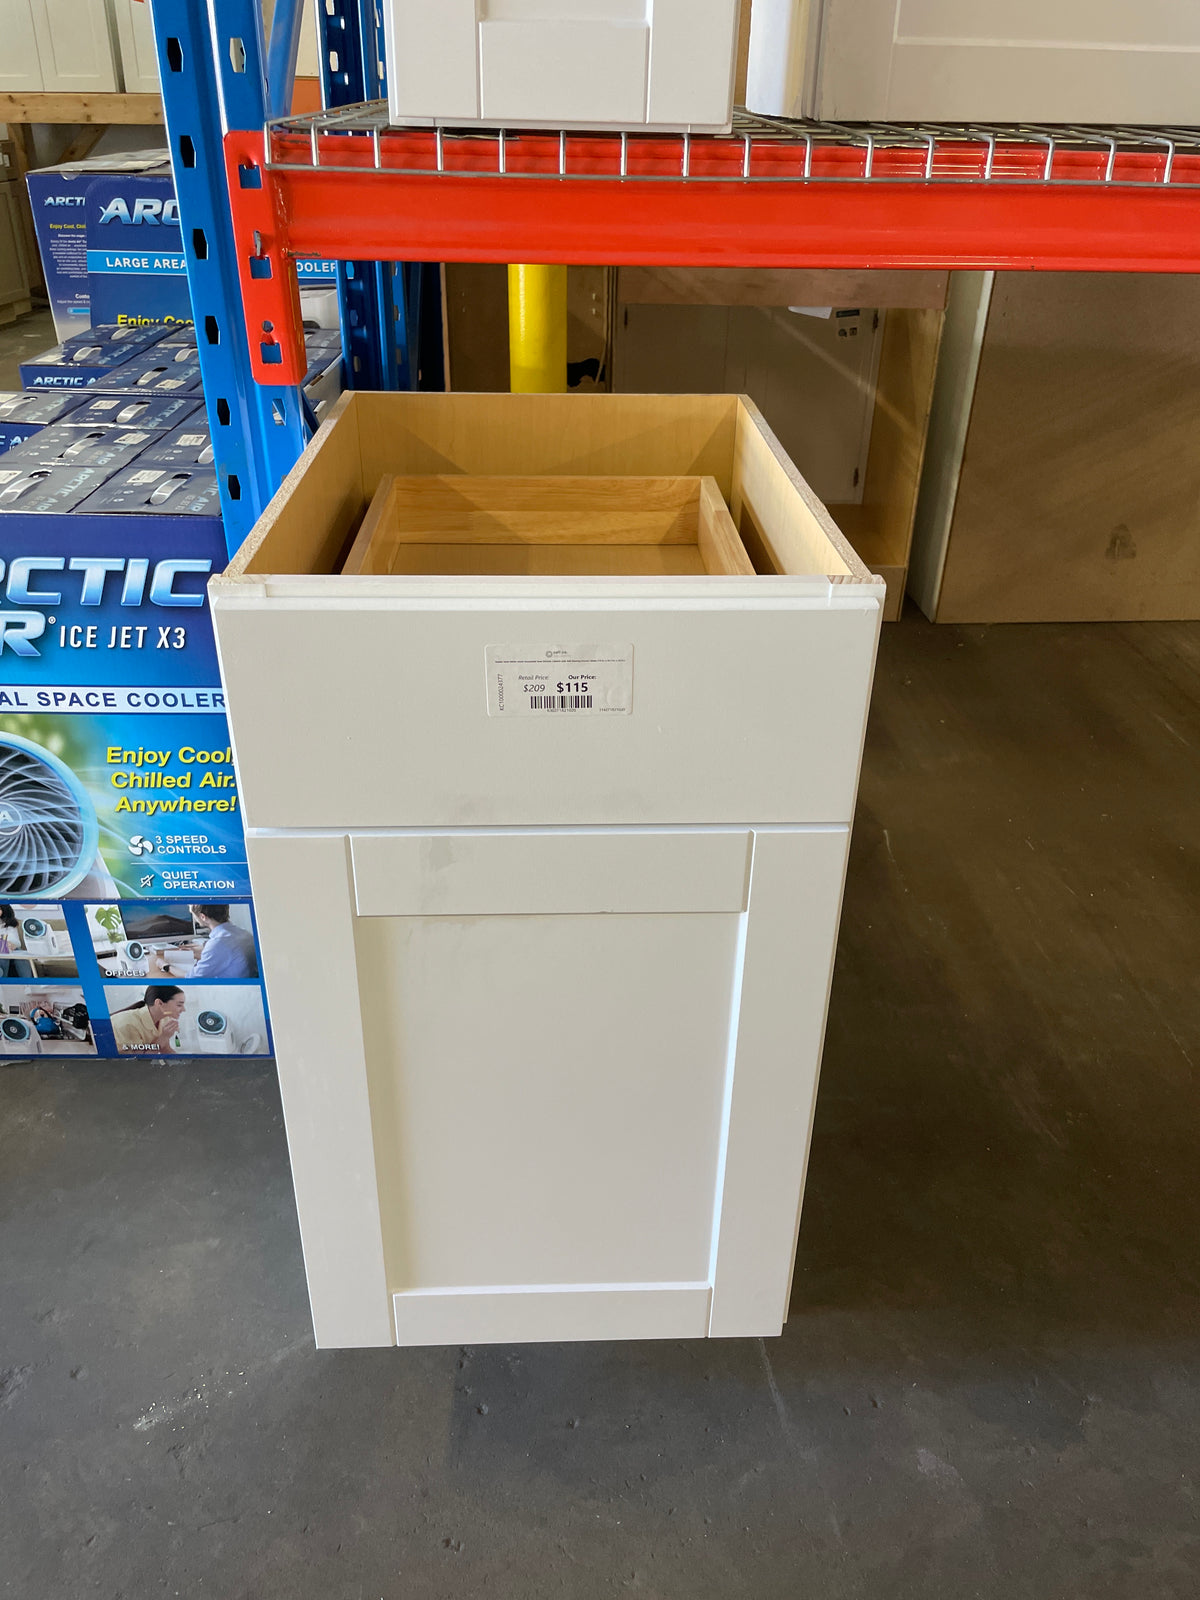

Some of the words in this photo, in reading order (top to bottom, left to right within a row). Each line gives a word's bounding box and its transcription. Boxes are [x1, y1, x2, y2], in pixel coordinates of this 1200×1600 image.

[106, 256, 150, 269] LARGE
[33, 376, 83, 386] ARCTIC
[0, 556, 213, 608] CTIC
[60, 624, 99, 648] ICE
[107, 626, 148, 649] JET
[156, 626, 187, 650] X3
[523, 684, 546, 693] $209
[556, 681, 589, 693] $115
[37, 691, 118, 708] SPACE
[126, 691, 227, 709] COOLER
[106, 746, 172, 768] Enjoy
[111, 771, 192, 789] Chilled
[199, 771, 236, 788] Air.
[115, 795, 237, 817] Anywhere!
[155, 835, 163, 845] 3
[166, 835, 209, 845] SPEED
[157, 845, 227, 855] CONTROLS
[161, 870, 199, 880] QUIET
[163, 880, 235, 890] OPERATION
[105, 969, 146, 978] OFFICES
[130, 1043, 161, 1051] MORE!
